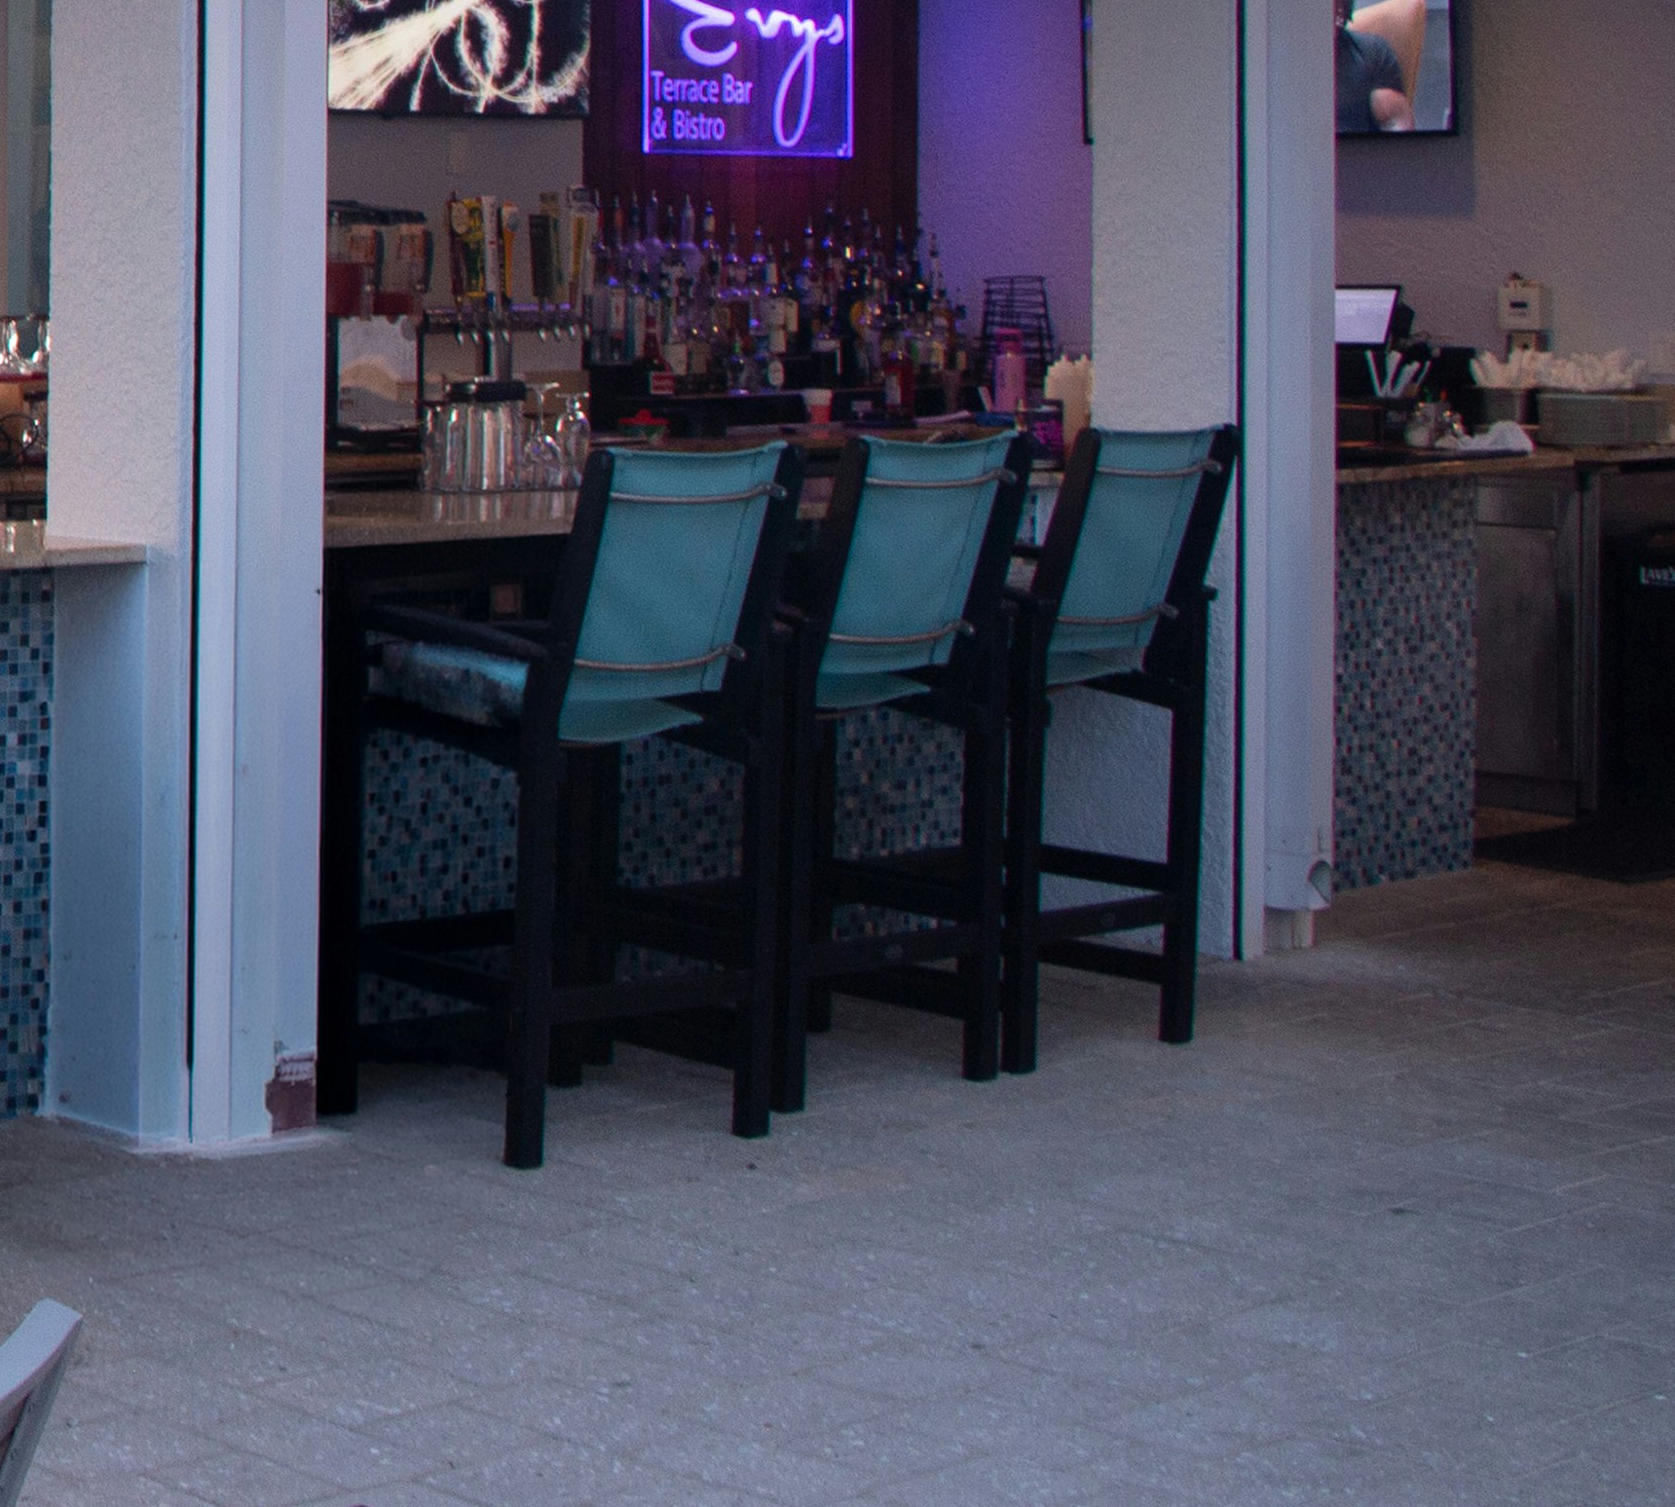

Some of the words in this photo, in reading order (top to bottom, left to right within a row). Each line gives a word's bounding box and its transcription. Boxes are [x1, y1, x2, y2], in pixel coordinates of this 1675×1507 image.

[651, 70, 718, 104] Terrace
[722, 72, 753, 105] Bar
[651, 106, 667, 140] &
[672, 109, 725, 141] Bistro
